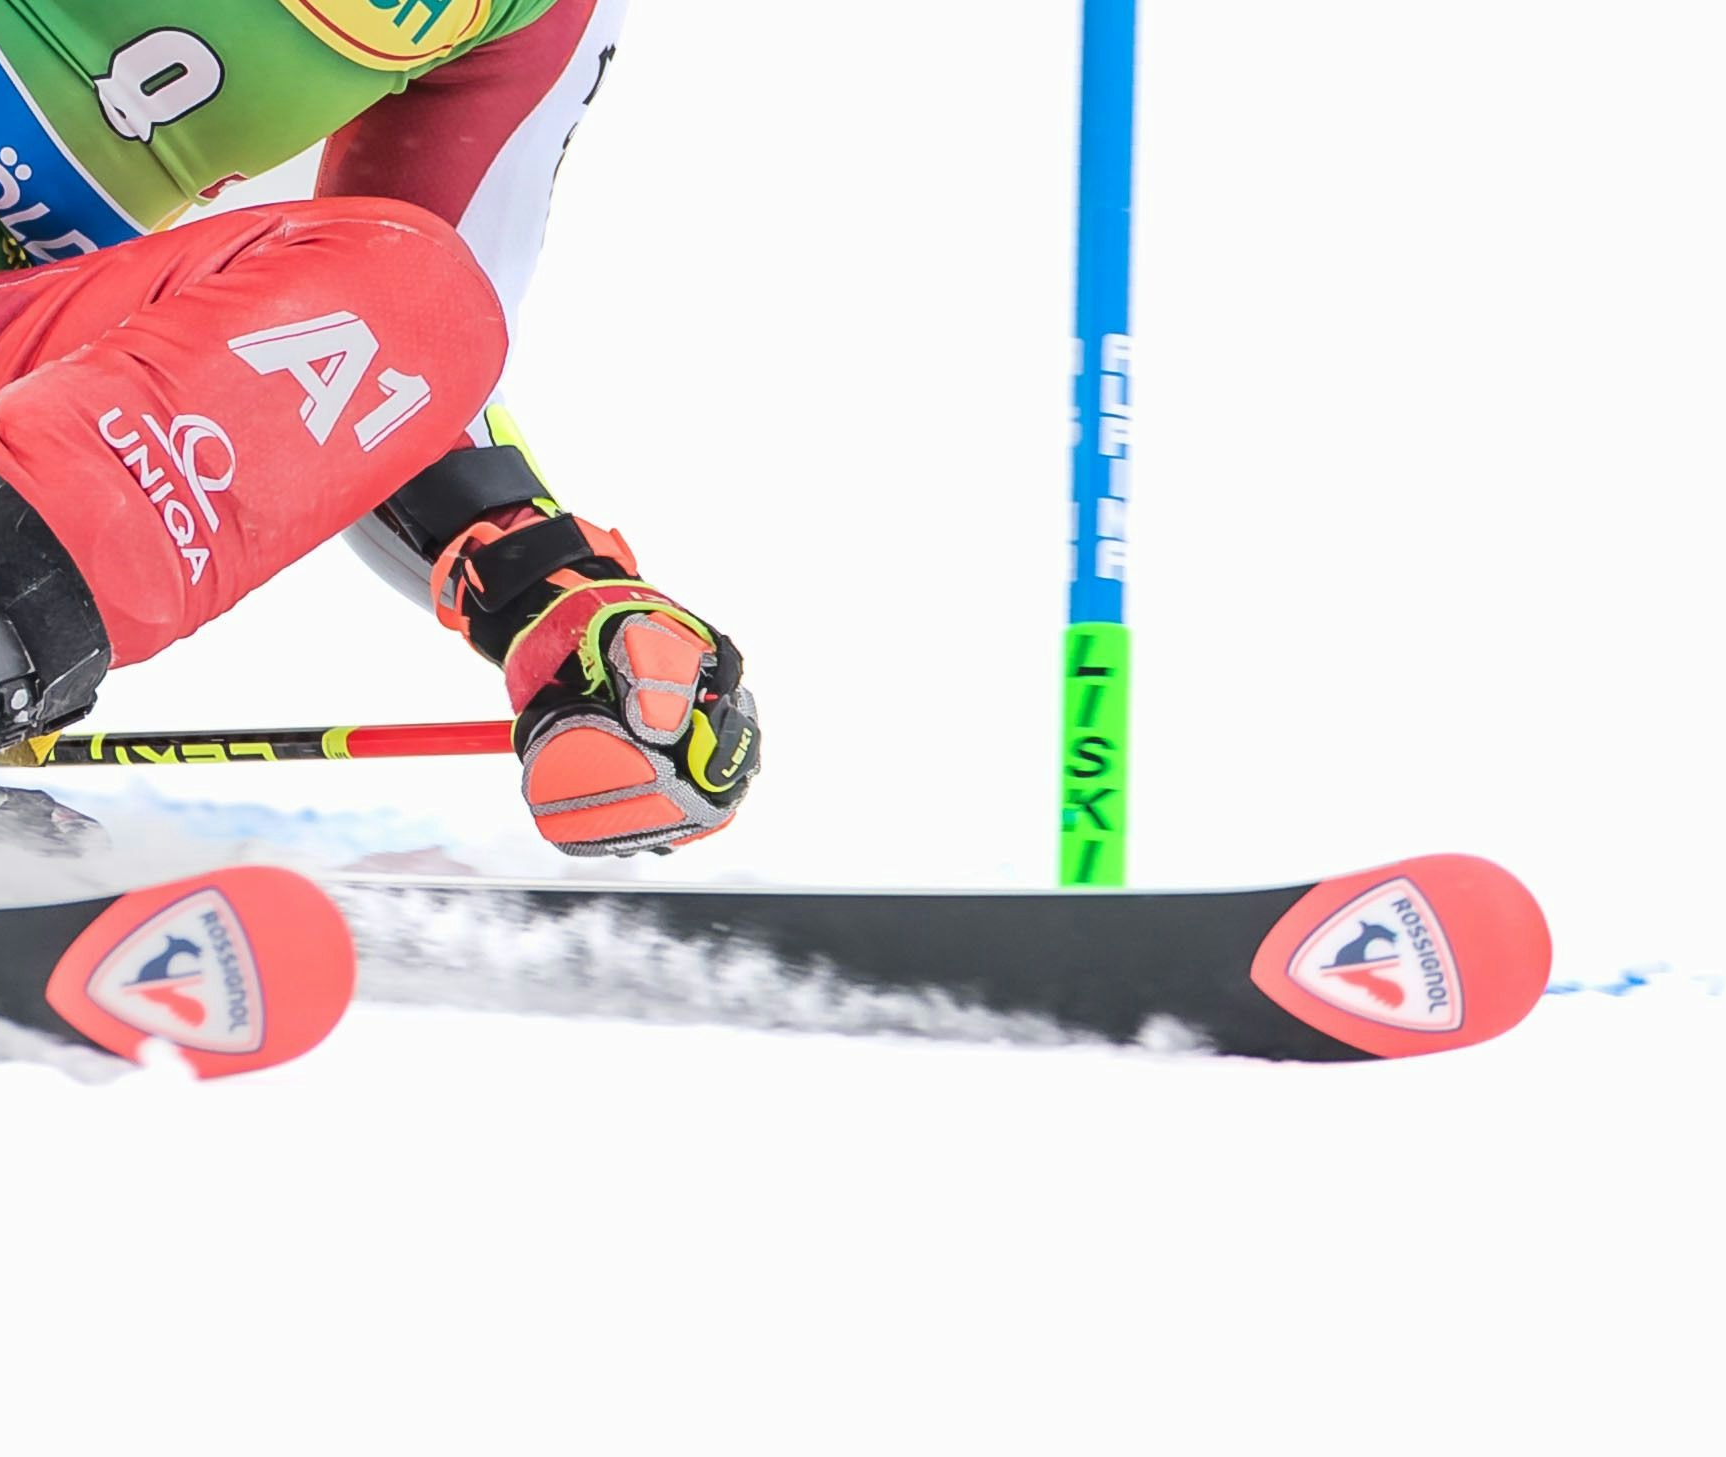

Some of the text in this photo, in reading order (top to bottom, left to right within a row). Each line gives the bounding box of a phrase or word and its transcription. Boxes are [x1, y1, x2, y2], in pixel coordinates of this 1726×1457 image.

[227, 311, 431, 452] A1
[97, 407, 211, 586] UNIQA
[1067, 634, 1117, 885] LISKI
[198, 909, 252, 1034] ROSSIGNOL
[1391, 896, 1449, 1014] ROSSIGNOL
